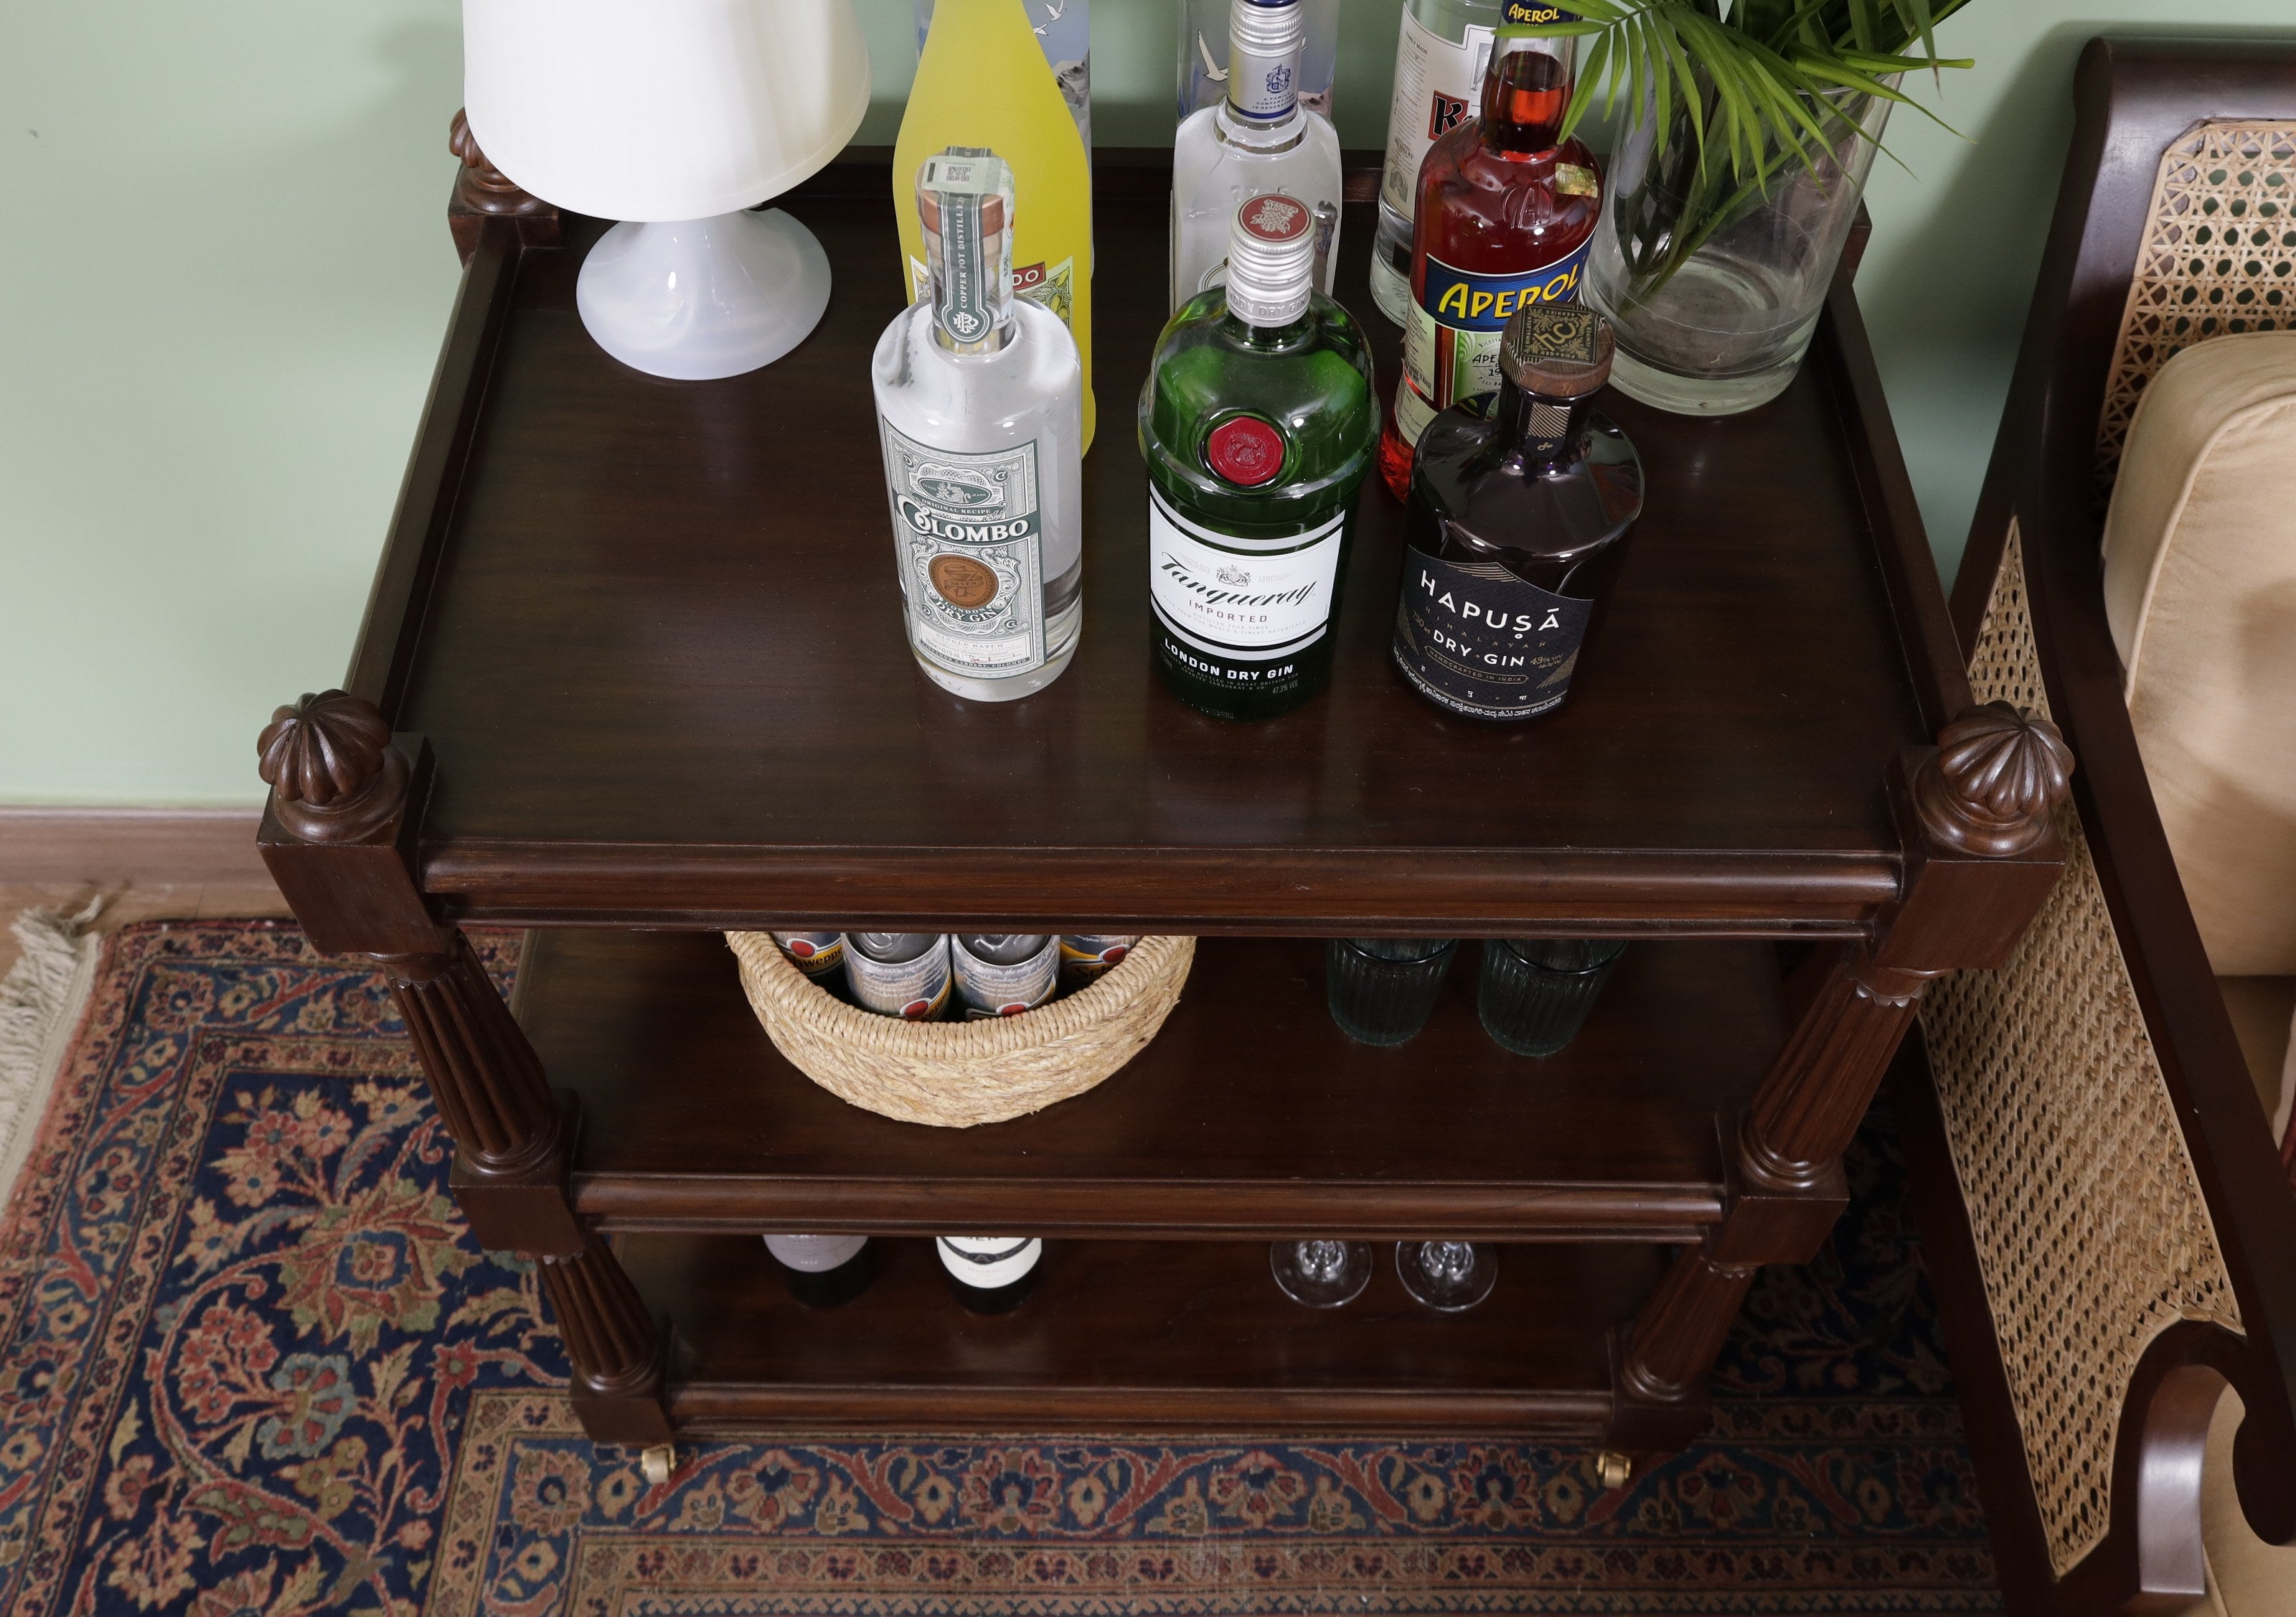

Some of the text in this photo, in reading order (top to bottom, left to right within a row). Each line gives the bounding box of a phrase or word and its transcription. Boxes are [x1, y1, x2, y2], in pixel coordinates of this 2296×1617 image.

[1508, 3, 1560, 23] APEROL
[956, 197, 966, 249] DISTILLED
[1258, 305, 1286, 316] DRY
[921, 498, 959, 513] ORIGINAL
[897, 493, 1030, 543] COLOMBO
[1161, 551, 1317, 607] Tanqueray
[936, 601, 999, 622] DRY GIN
[944, 601, 986, 614] LONDON
[1188, 599, 1268, 623] IMPORTED
[1426, 606, 1546, 649] HIMALAYAN
[1165, 637, 1294, 680] LONDON DRY GIN
[1434, 629, 1525, 667] DRY GIN
[1429, 650, 1483, 678] HANDCRAFTED
[1209, 680, 1246, 690] TANQUERAY
[1272, 683, 1289, 695] 47.3%
